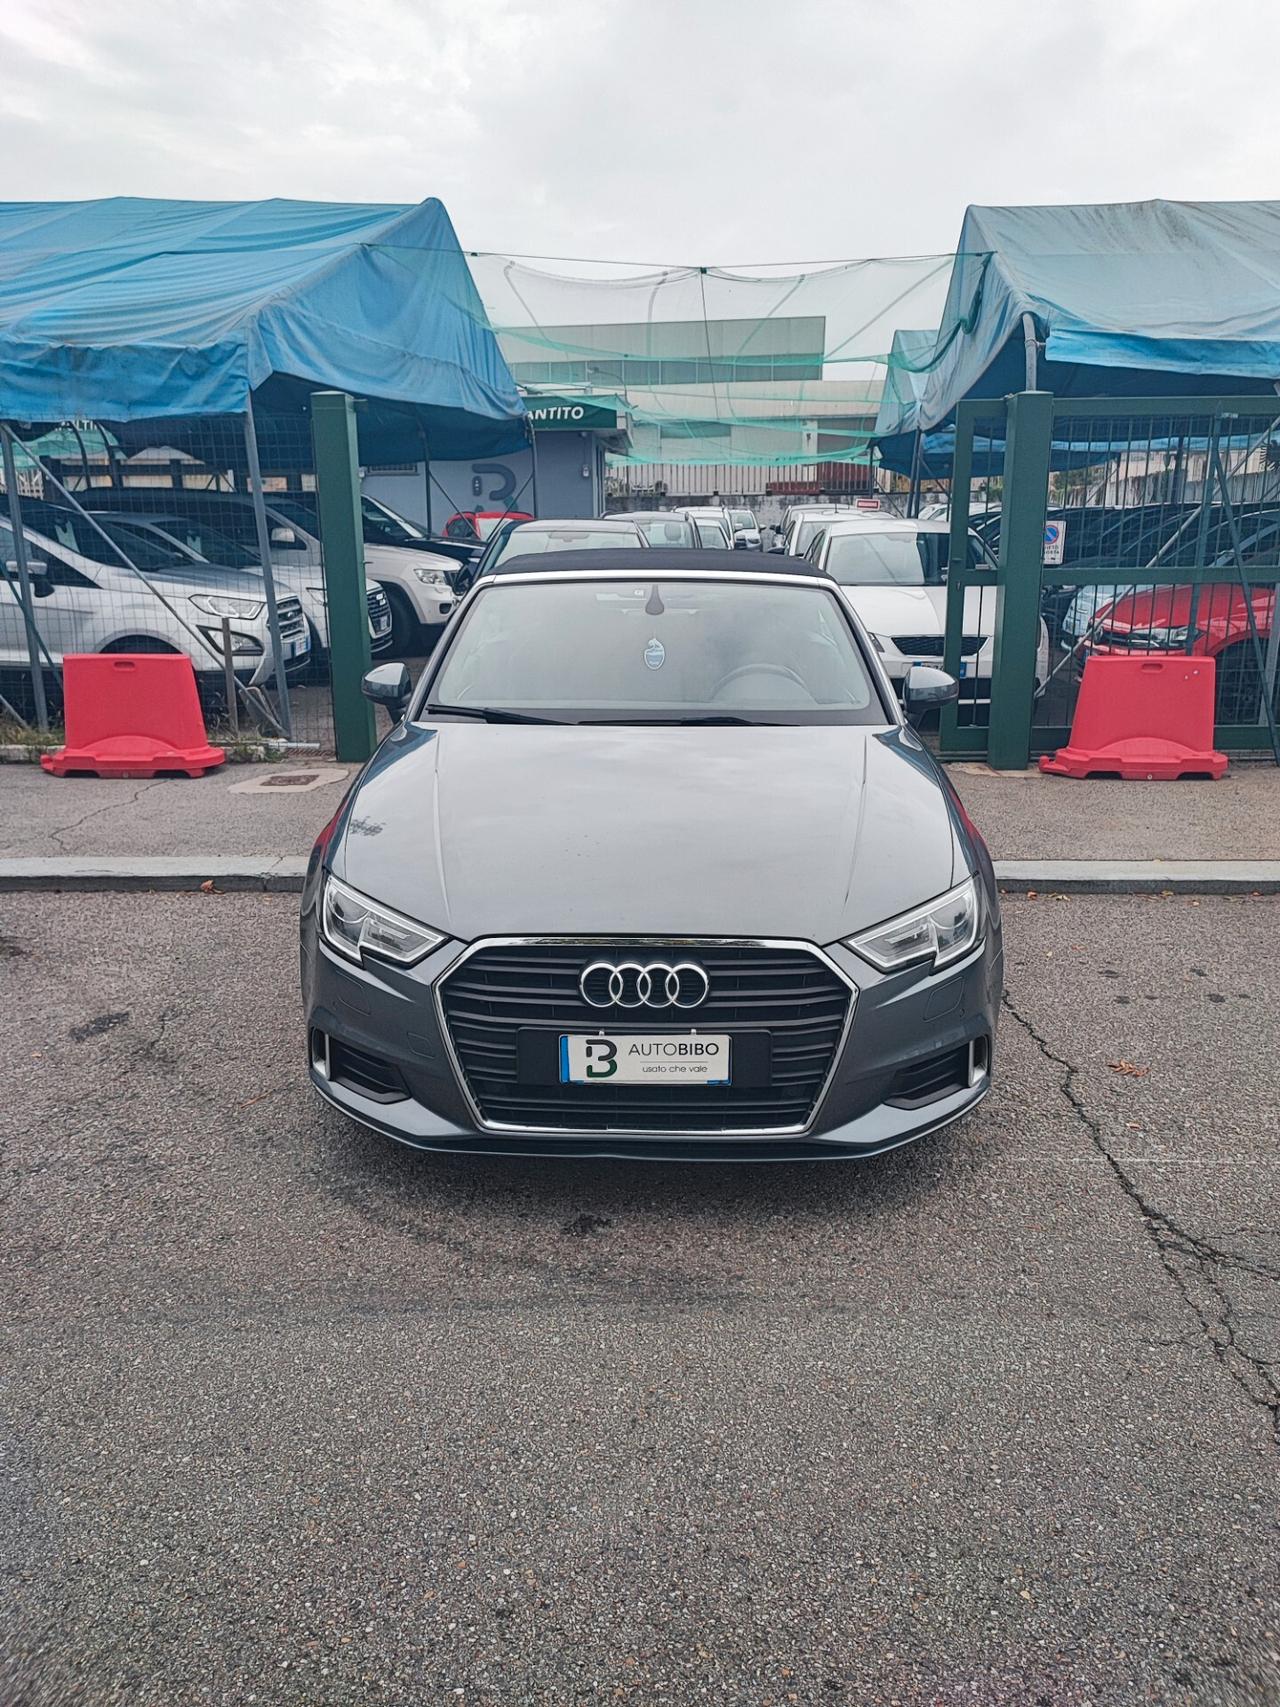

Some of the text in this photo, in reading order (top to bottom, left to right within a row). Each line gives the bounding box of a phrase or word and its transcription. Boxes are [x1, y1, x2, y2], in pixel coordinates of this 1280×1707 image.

[628, 1042, 719, 1056] AUTOBIBO
[642, 1065, 708, 1073] usato che vale
